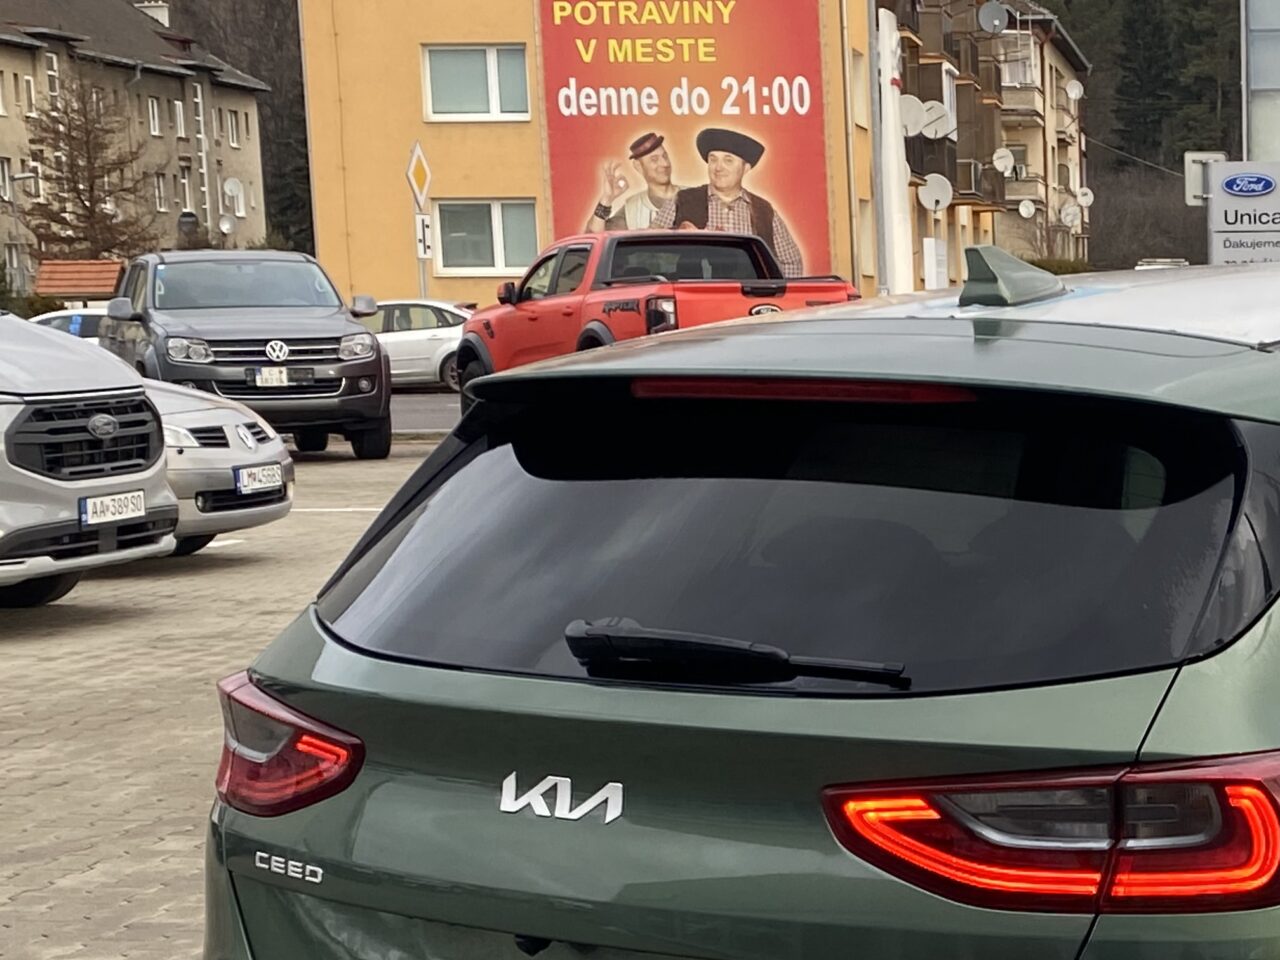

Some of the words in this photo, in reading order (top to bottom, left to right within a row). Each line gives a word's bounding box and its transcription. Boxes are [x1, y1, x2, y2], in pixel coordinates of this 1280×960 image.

[553, 1, 736, 25] POTRAVINY
[576, 39, 597, 63] V
[608, 38, 717, 62] MESTE
[558, 77, 659, 116] denne
[670, 77, 710, 115] do
[721, 76, 811, 115] 21:00
[500, 771, 623, 824] KIA
[255, 851, 324, 883] CEED
